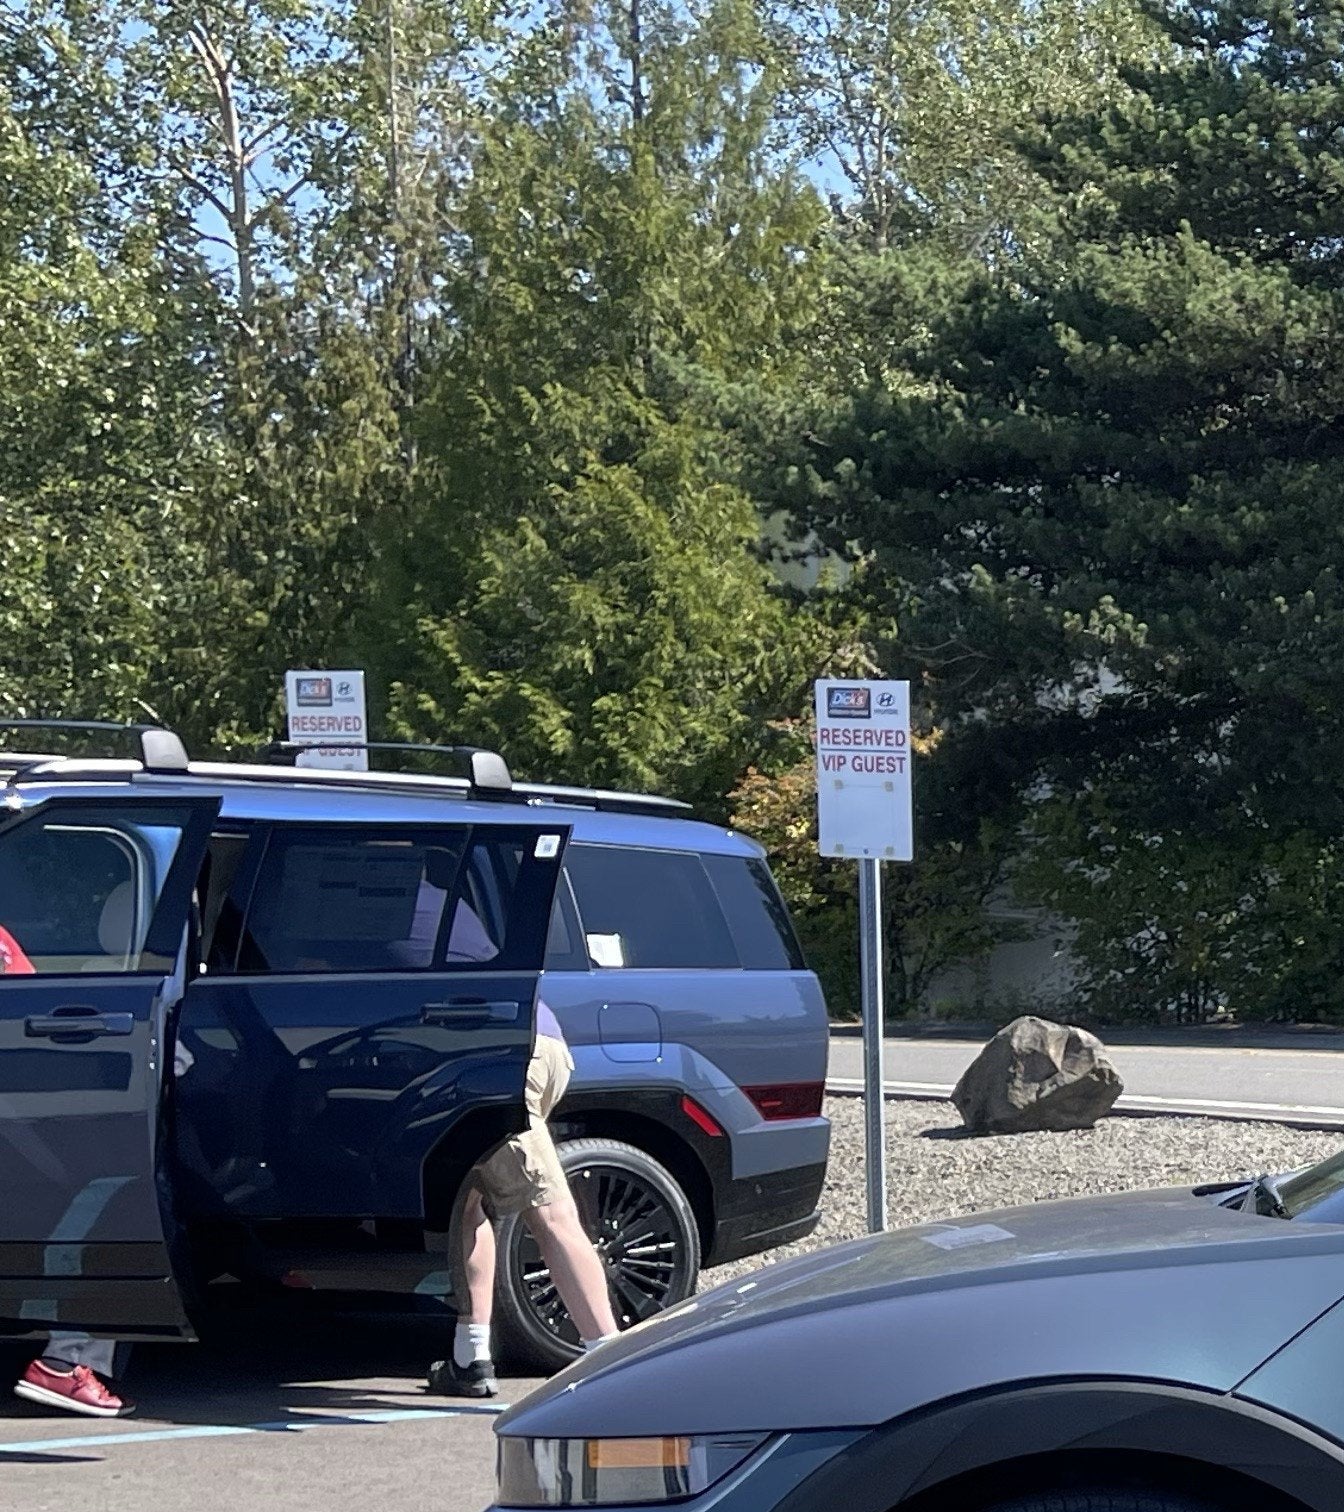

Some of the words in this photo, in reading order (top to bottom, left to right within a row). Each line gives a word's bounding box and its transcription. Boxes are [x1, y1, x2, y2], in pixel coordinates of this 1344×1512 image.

[292, 716, 362, 732] RESERVED
[820, 728, 906, 747] RESERVED
[822, 754, 846, 772] VIP
[851, 755, 906, 774] GUEST
